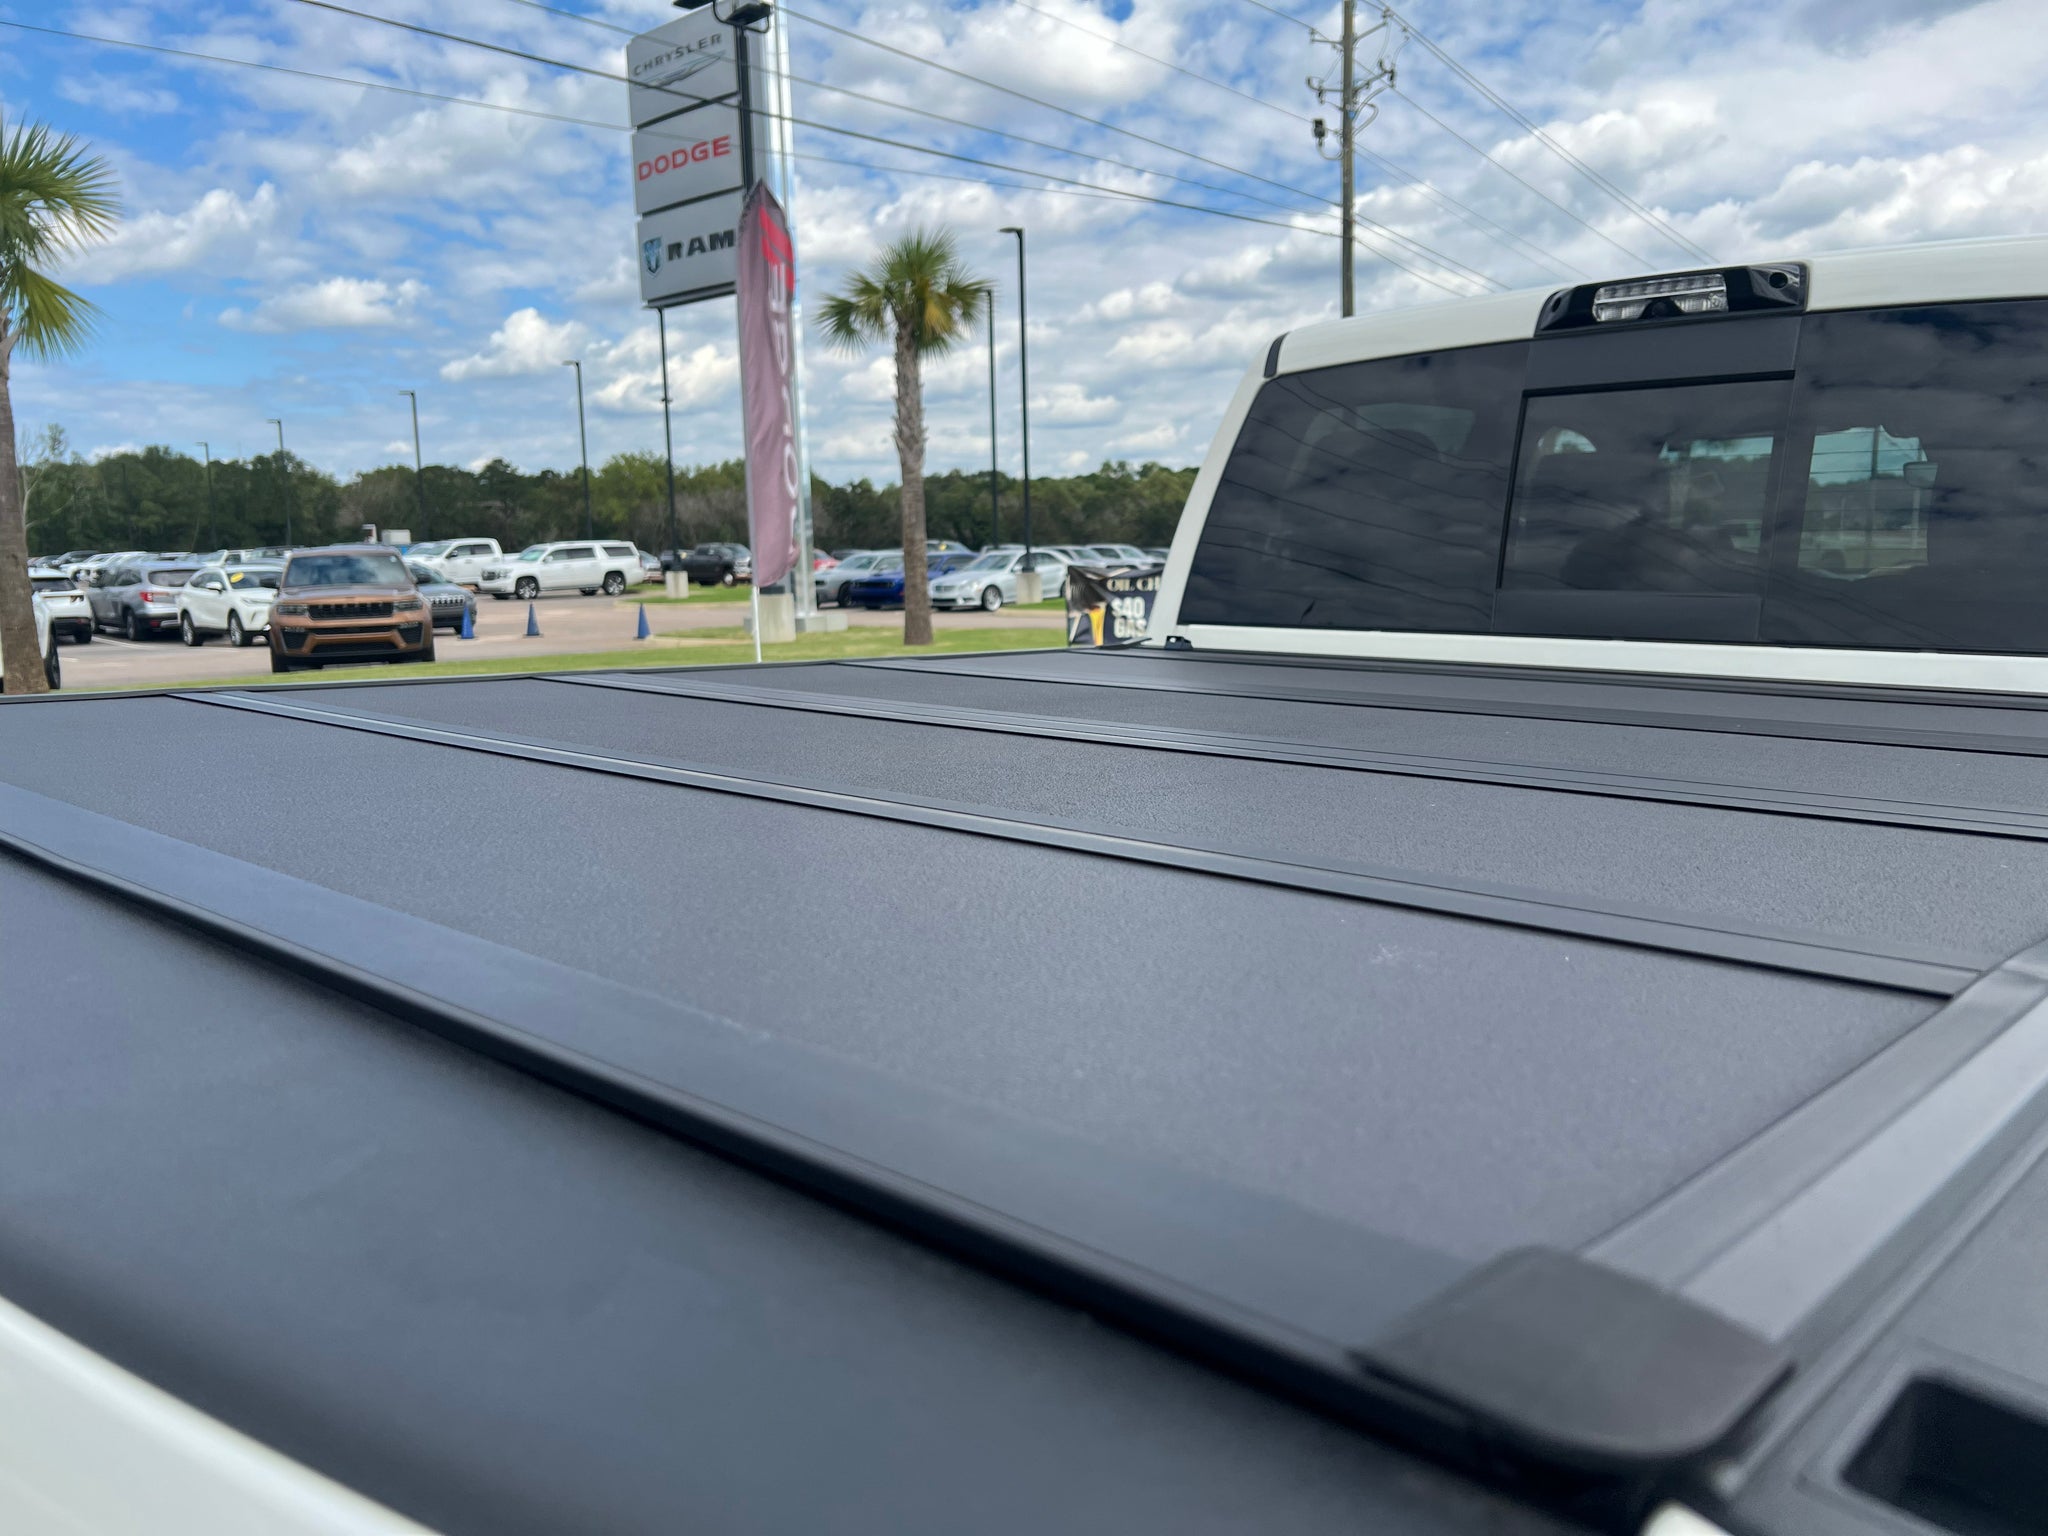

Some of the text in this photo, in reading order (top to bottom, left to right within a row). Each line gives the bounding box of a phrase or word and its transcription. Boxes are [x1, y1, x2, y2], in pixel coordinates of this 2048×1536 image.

[633, 33, 722, 76] CHRYSLER
[638, 135, 731, 181] DODGE
[668, 230, 734, 261] RAM
[1114, 618, 1147, 638] GAS
